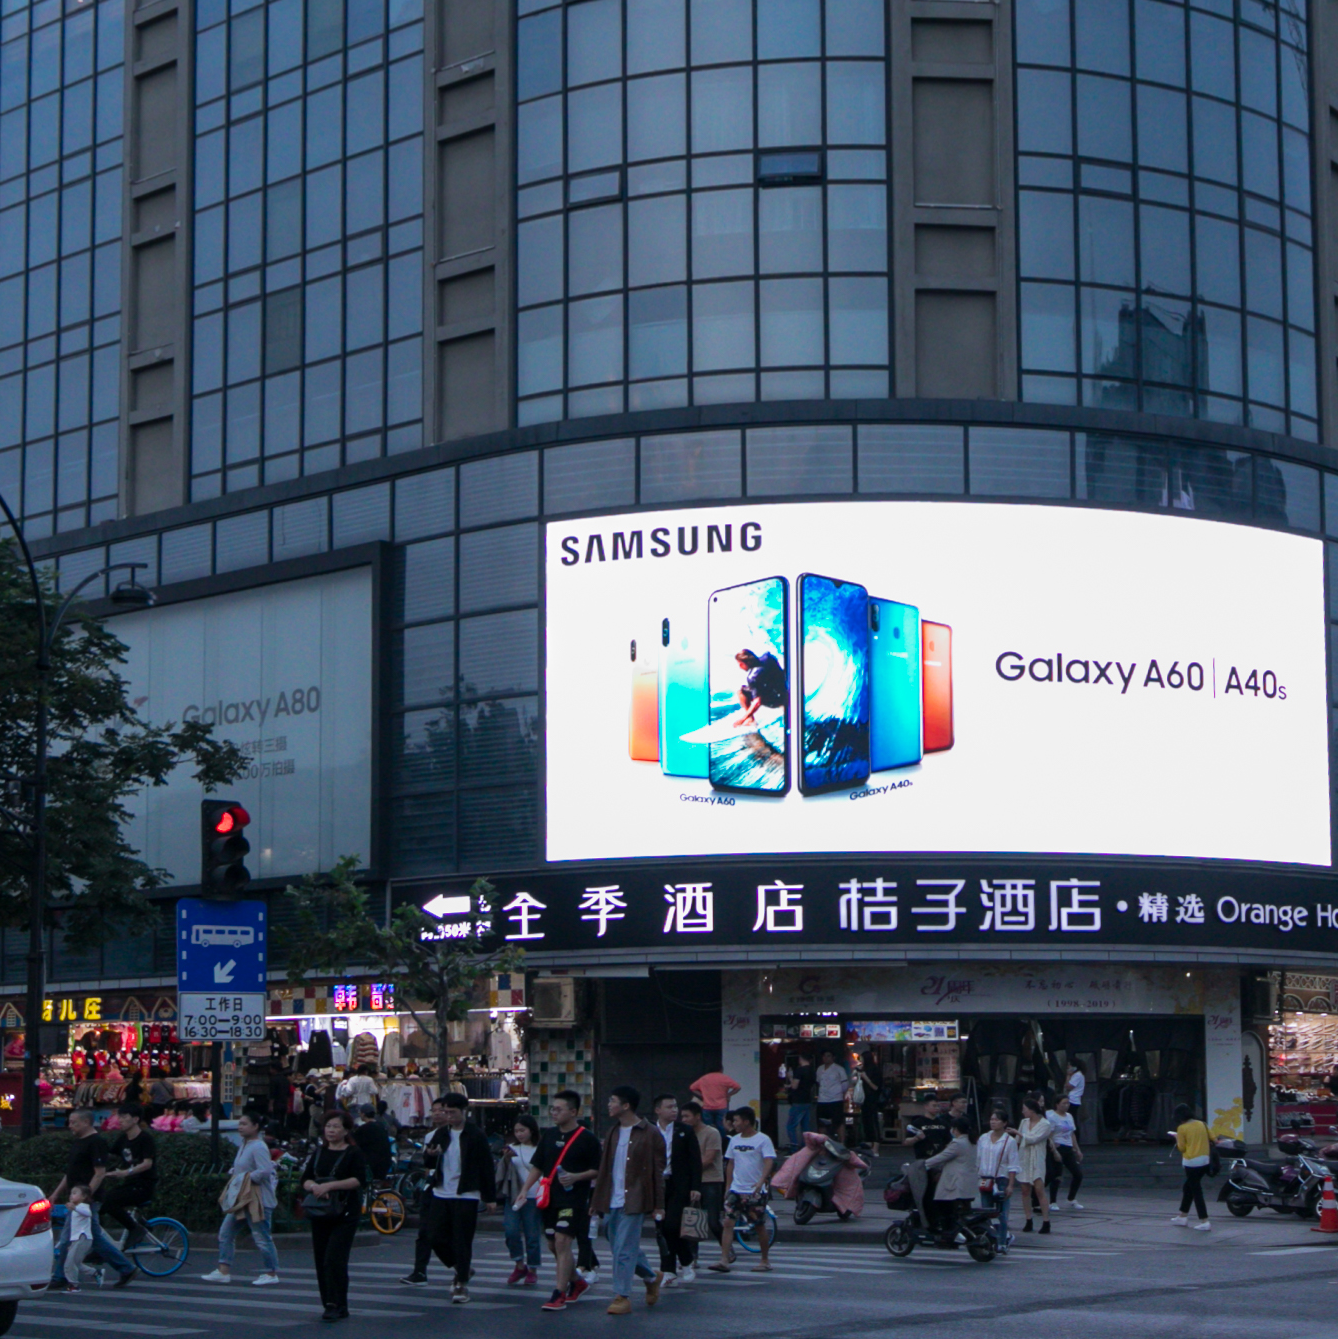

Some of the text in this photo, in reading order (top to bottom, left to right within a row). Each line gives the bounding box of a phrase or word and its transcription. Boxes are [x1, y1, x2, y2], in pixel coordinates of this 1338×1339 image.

[560, 521, 763, 566] SAMSUNG
[995, 651, 1288, 700] Galaxy A60 A40s
[182, 685, 321, 728] Galaxy A80
[679, 793, 736, 806] Galaxy A60
[849, 784, 889, 801] Galaxy
[502, 879, 804, 940] 全季酒店
[1217, 895, 1307, 932] Orange
[205, 997, 243, 1012] 工作日
